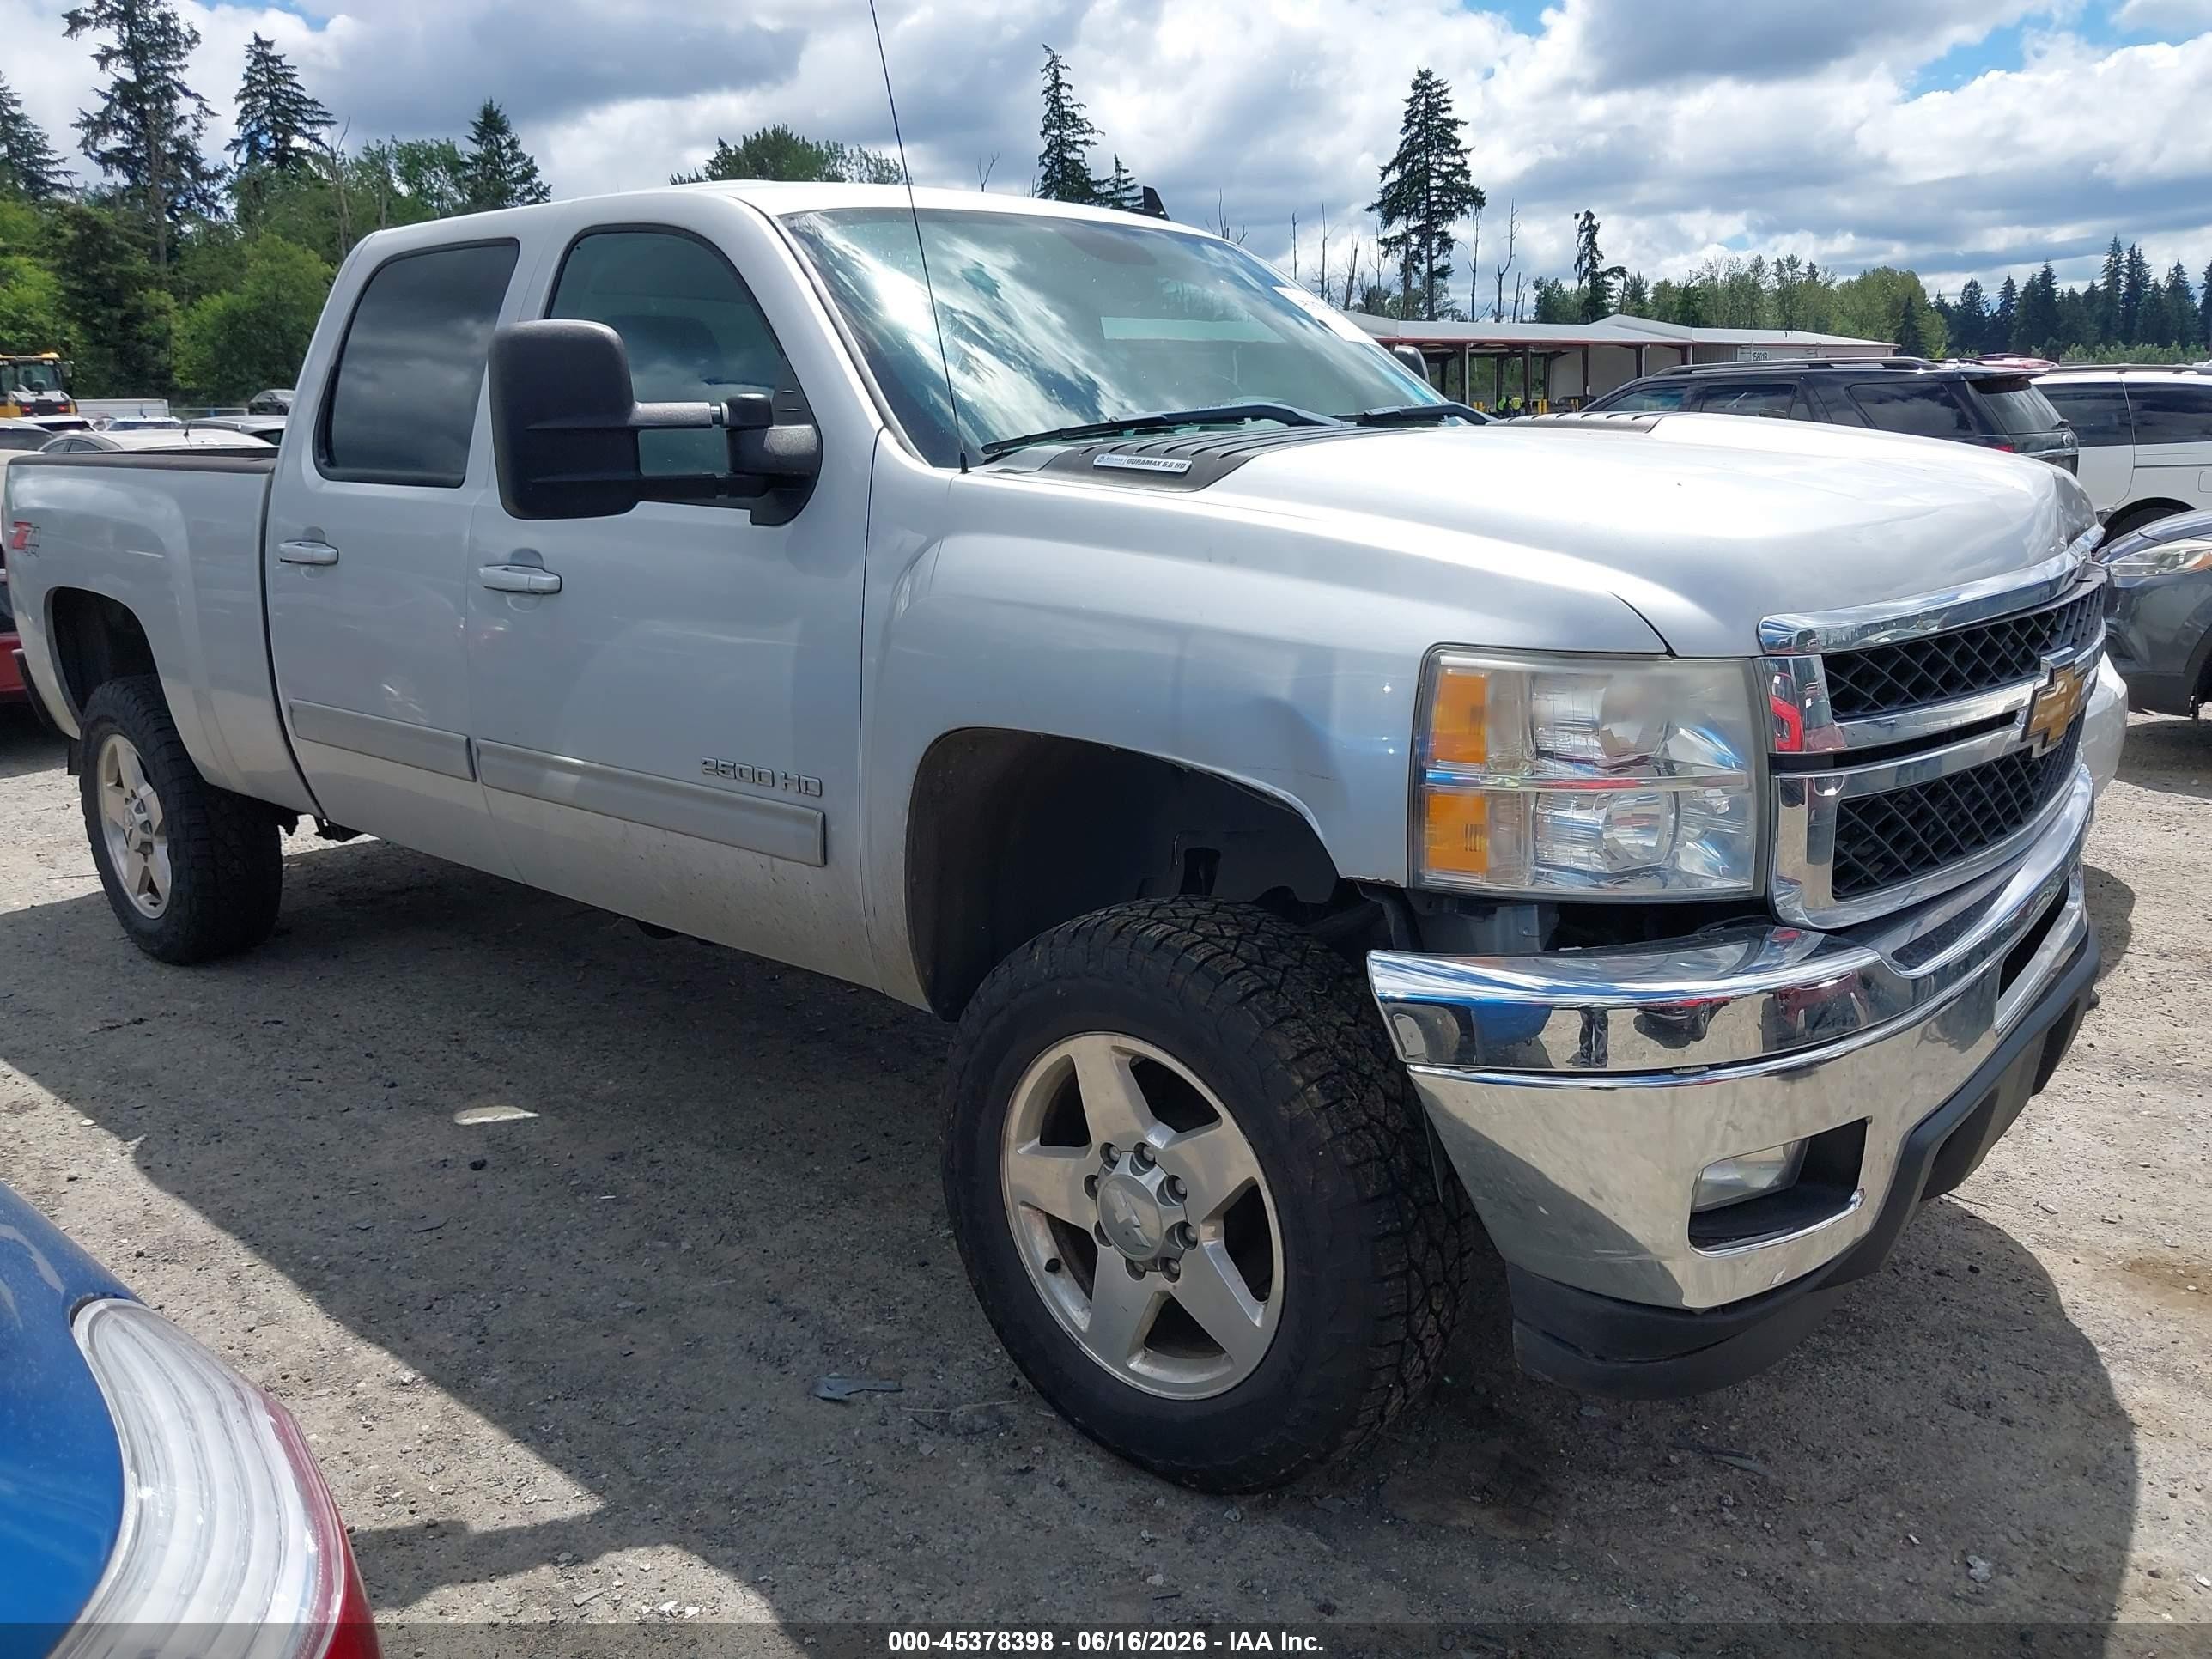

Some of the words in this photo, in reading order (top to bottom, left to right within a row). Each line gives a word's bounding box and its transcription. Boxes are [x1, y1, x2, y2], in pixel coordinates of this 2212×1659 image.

[1126, 458, 1161, 467] DURAMAX
[701, 757, 775, 787] 2500
[781, 771, 822, 797] HD
